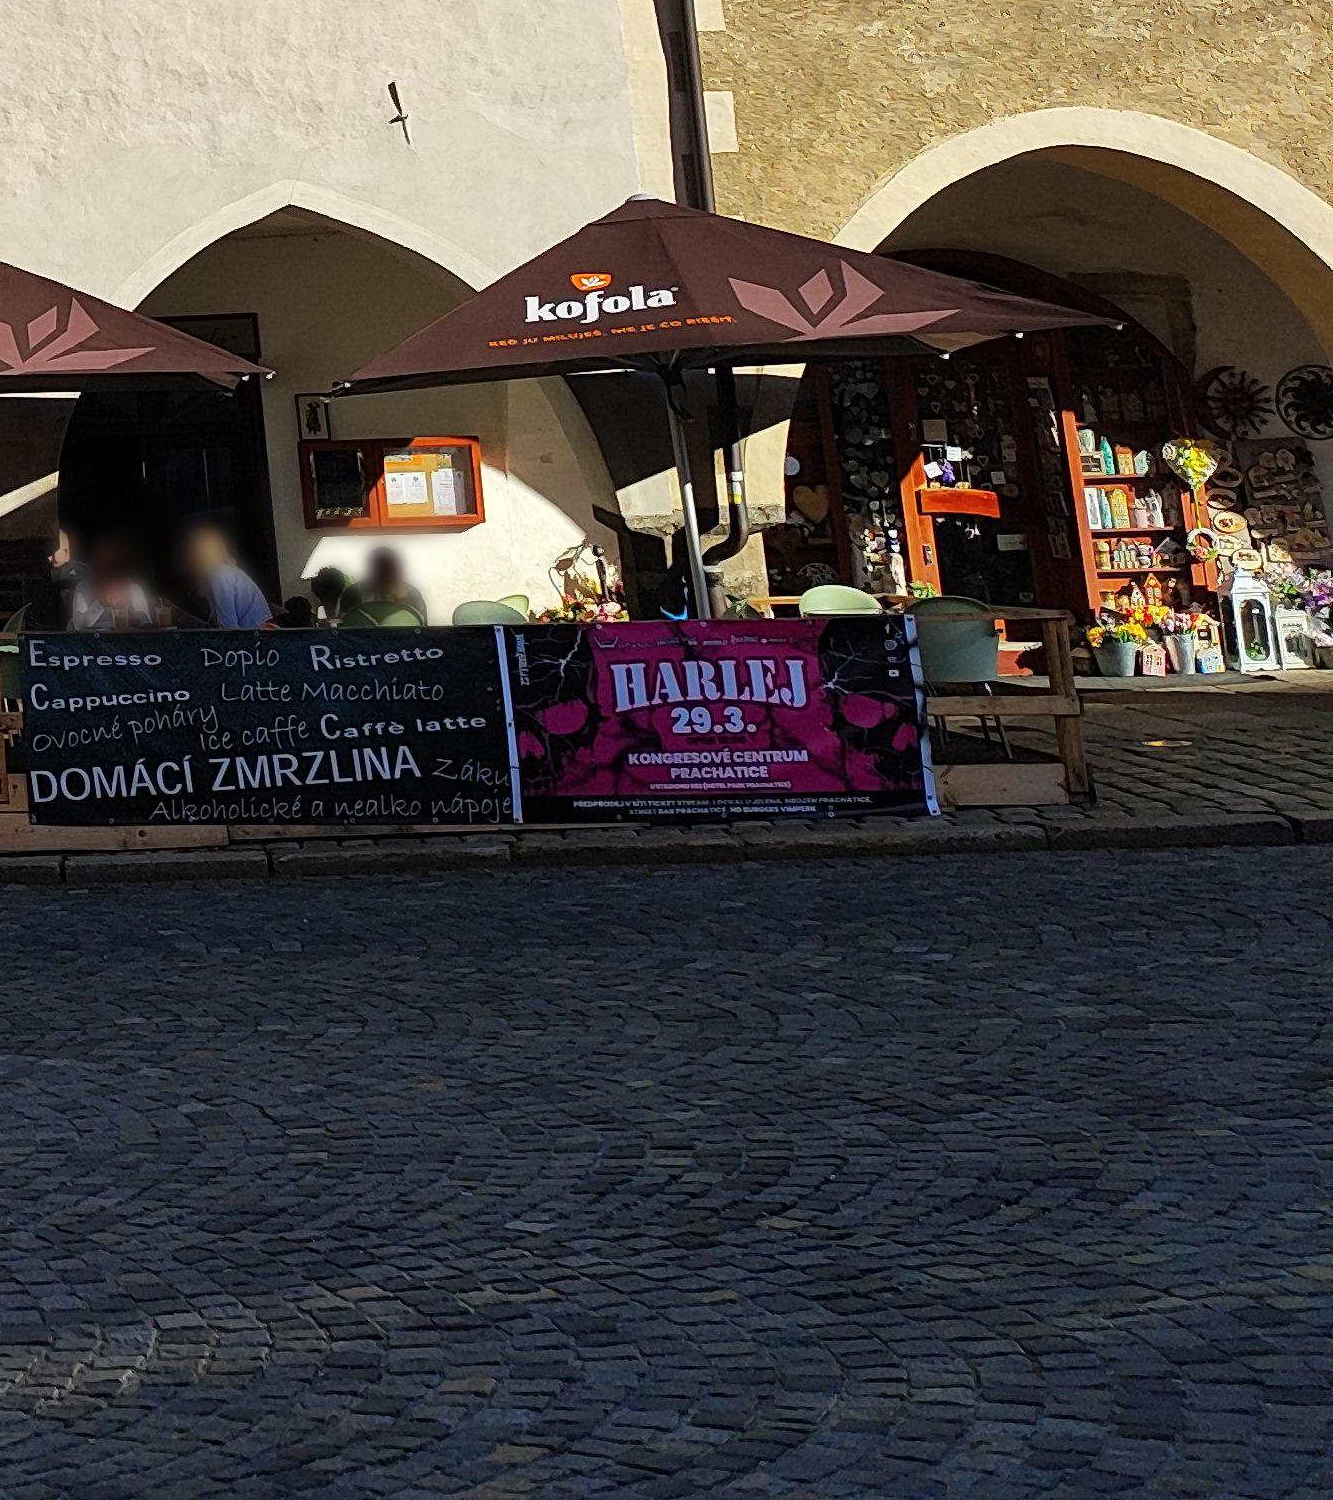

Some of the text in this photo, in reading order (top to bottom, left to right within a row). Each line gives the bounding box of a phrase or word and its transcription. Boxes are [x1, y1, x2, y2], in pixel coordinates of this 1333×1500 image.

[524, 285, 678, 323] kofola
[29, 639, 162, 670] Espresso
[309, 644, 444, 672] Ristretto
[30, 677, 444, 712] Cappuccino Latte Macchiato
[610, 659, 808, 713] HARLEJ
[127, 703, 219, 745] poháry
[242, 714, 310, 749] caffe
[319, 713, 405, 740] Caffè
[416, 716, 487, 732] latte
[671, 706, 757, 734] 29.3.
[30, 754, 193, 803] DOMÁCÍ
[208, 745, 422, 792] ZMRZLINA
[628, 747, 809, 766] KONGRESOVÉ CENTRUM
[670, 765, 769, 780] PRACHATICE
[148, 790, 512, 822] Alkoholické a nealko nápoje
